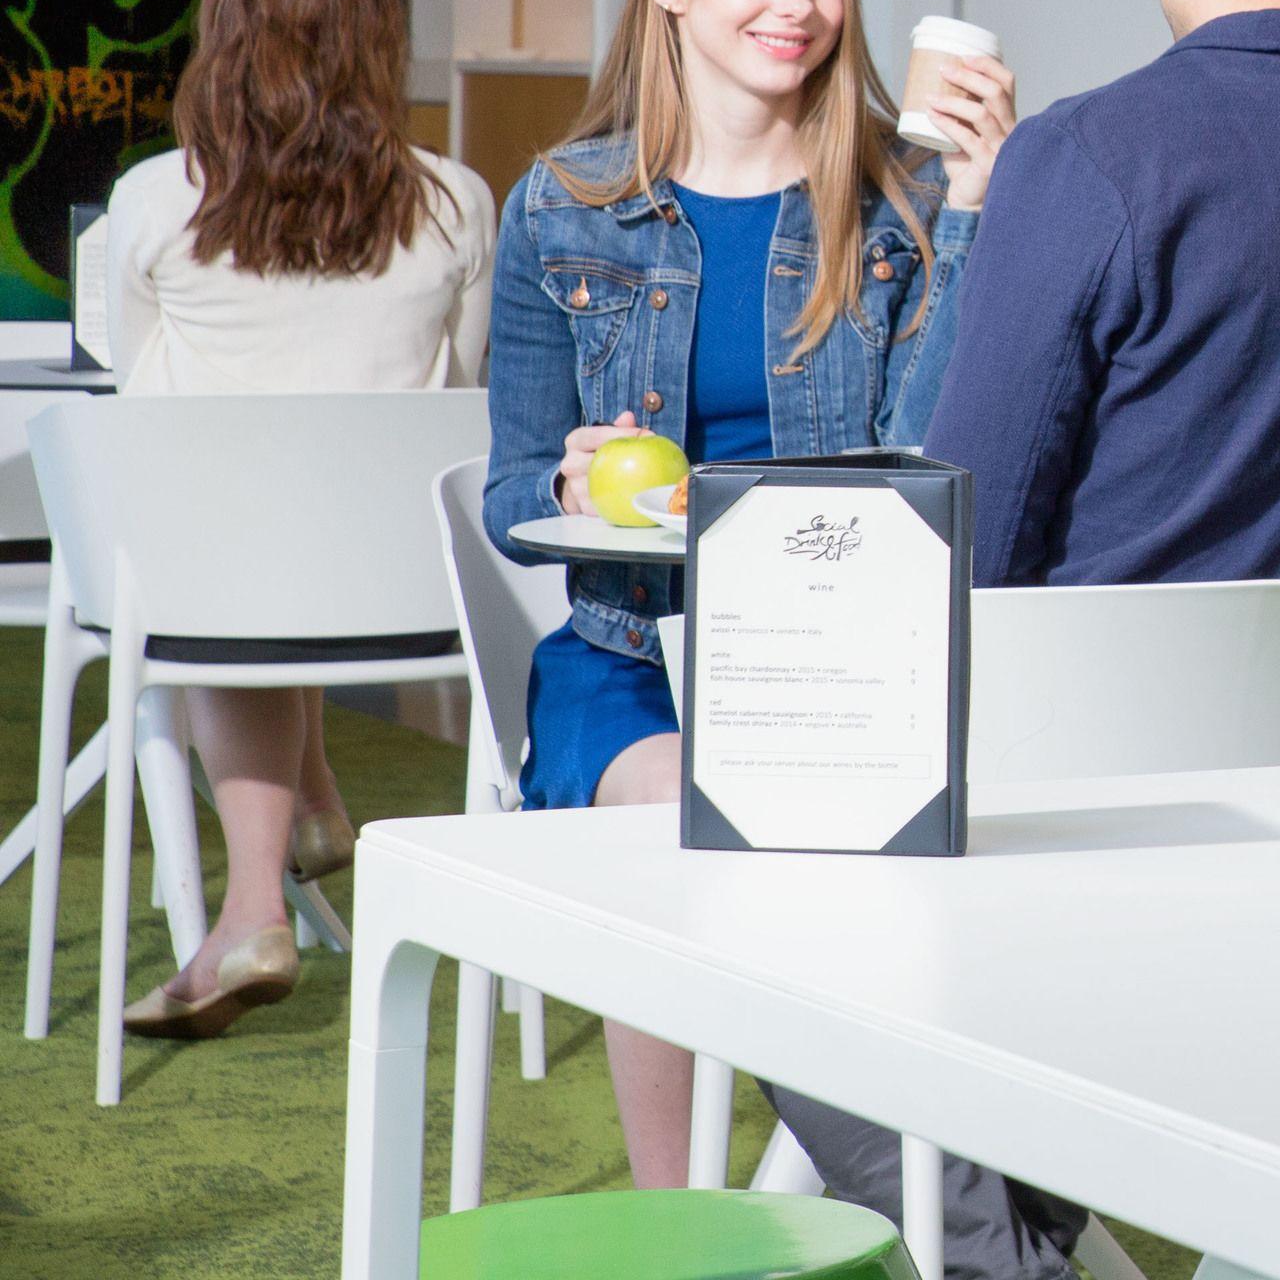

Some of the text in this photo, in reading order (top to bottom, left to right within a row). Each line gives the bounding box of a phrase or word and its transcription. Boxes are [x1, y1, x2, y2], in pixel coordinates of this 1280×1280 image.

[796, 514, 861, 534] Social
[783, 533, 825, 554] Drink
[808, 582, 835, 592] wine
[711, 612, 741, 621] bubbles
[711, 651, 730, 659] white
[710, 664, 733, 674] pacific
[734, 665, 747, 675] bay
[749, 665, 790, 675] chardonnay
[747, 675, 783, 684] sauvignon
[783, 675, 803, 683] blanc
[739, 710, 770, 718] cabernet
[772, 711, 808, 720] sauvignon
